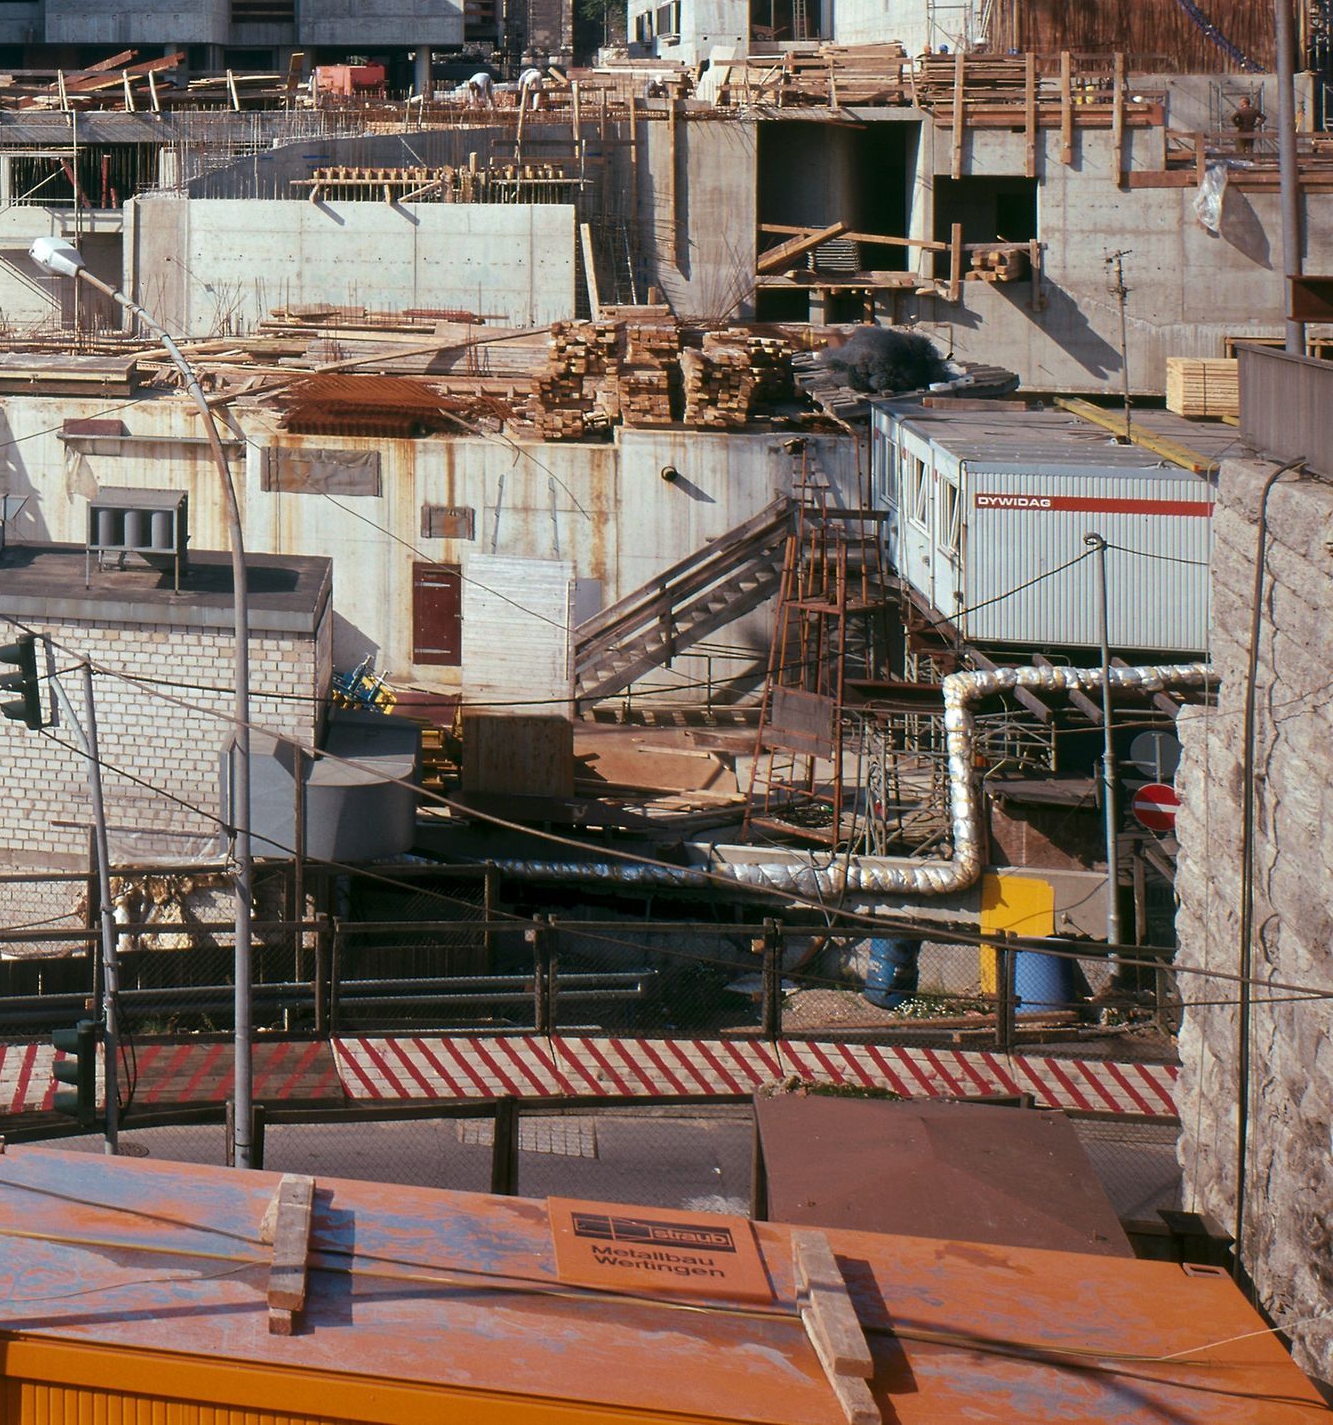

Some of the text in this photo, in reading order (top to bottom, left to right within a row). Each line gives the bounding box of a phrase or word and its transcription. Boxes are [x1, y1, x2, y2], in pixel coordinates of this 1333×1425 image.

[977, 496, 1051, 508] DYWIDAG
[653, 1226, 731, 1247] straub
[591, 1244, 715, 1267] Metallbau
[593, 1254, 726, 1279] Wertingen
